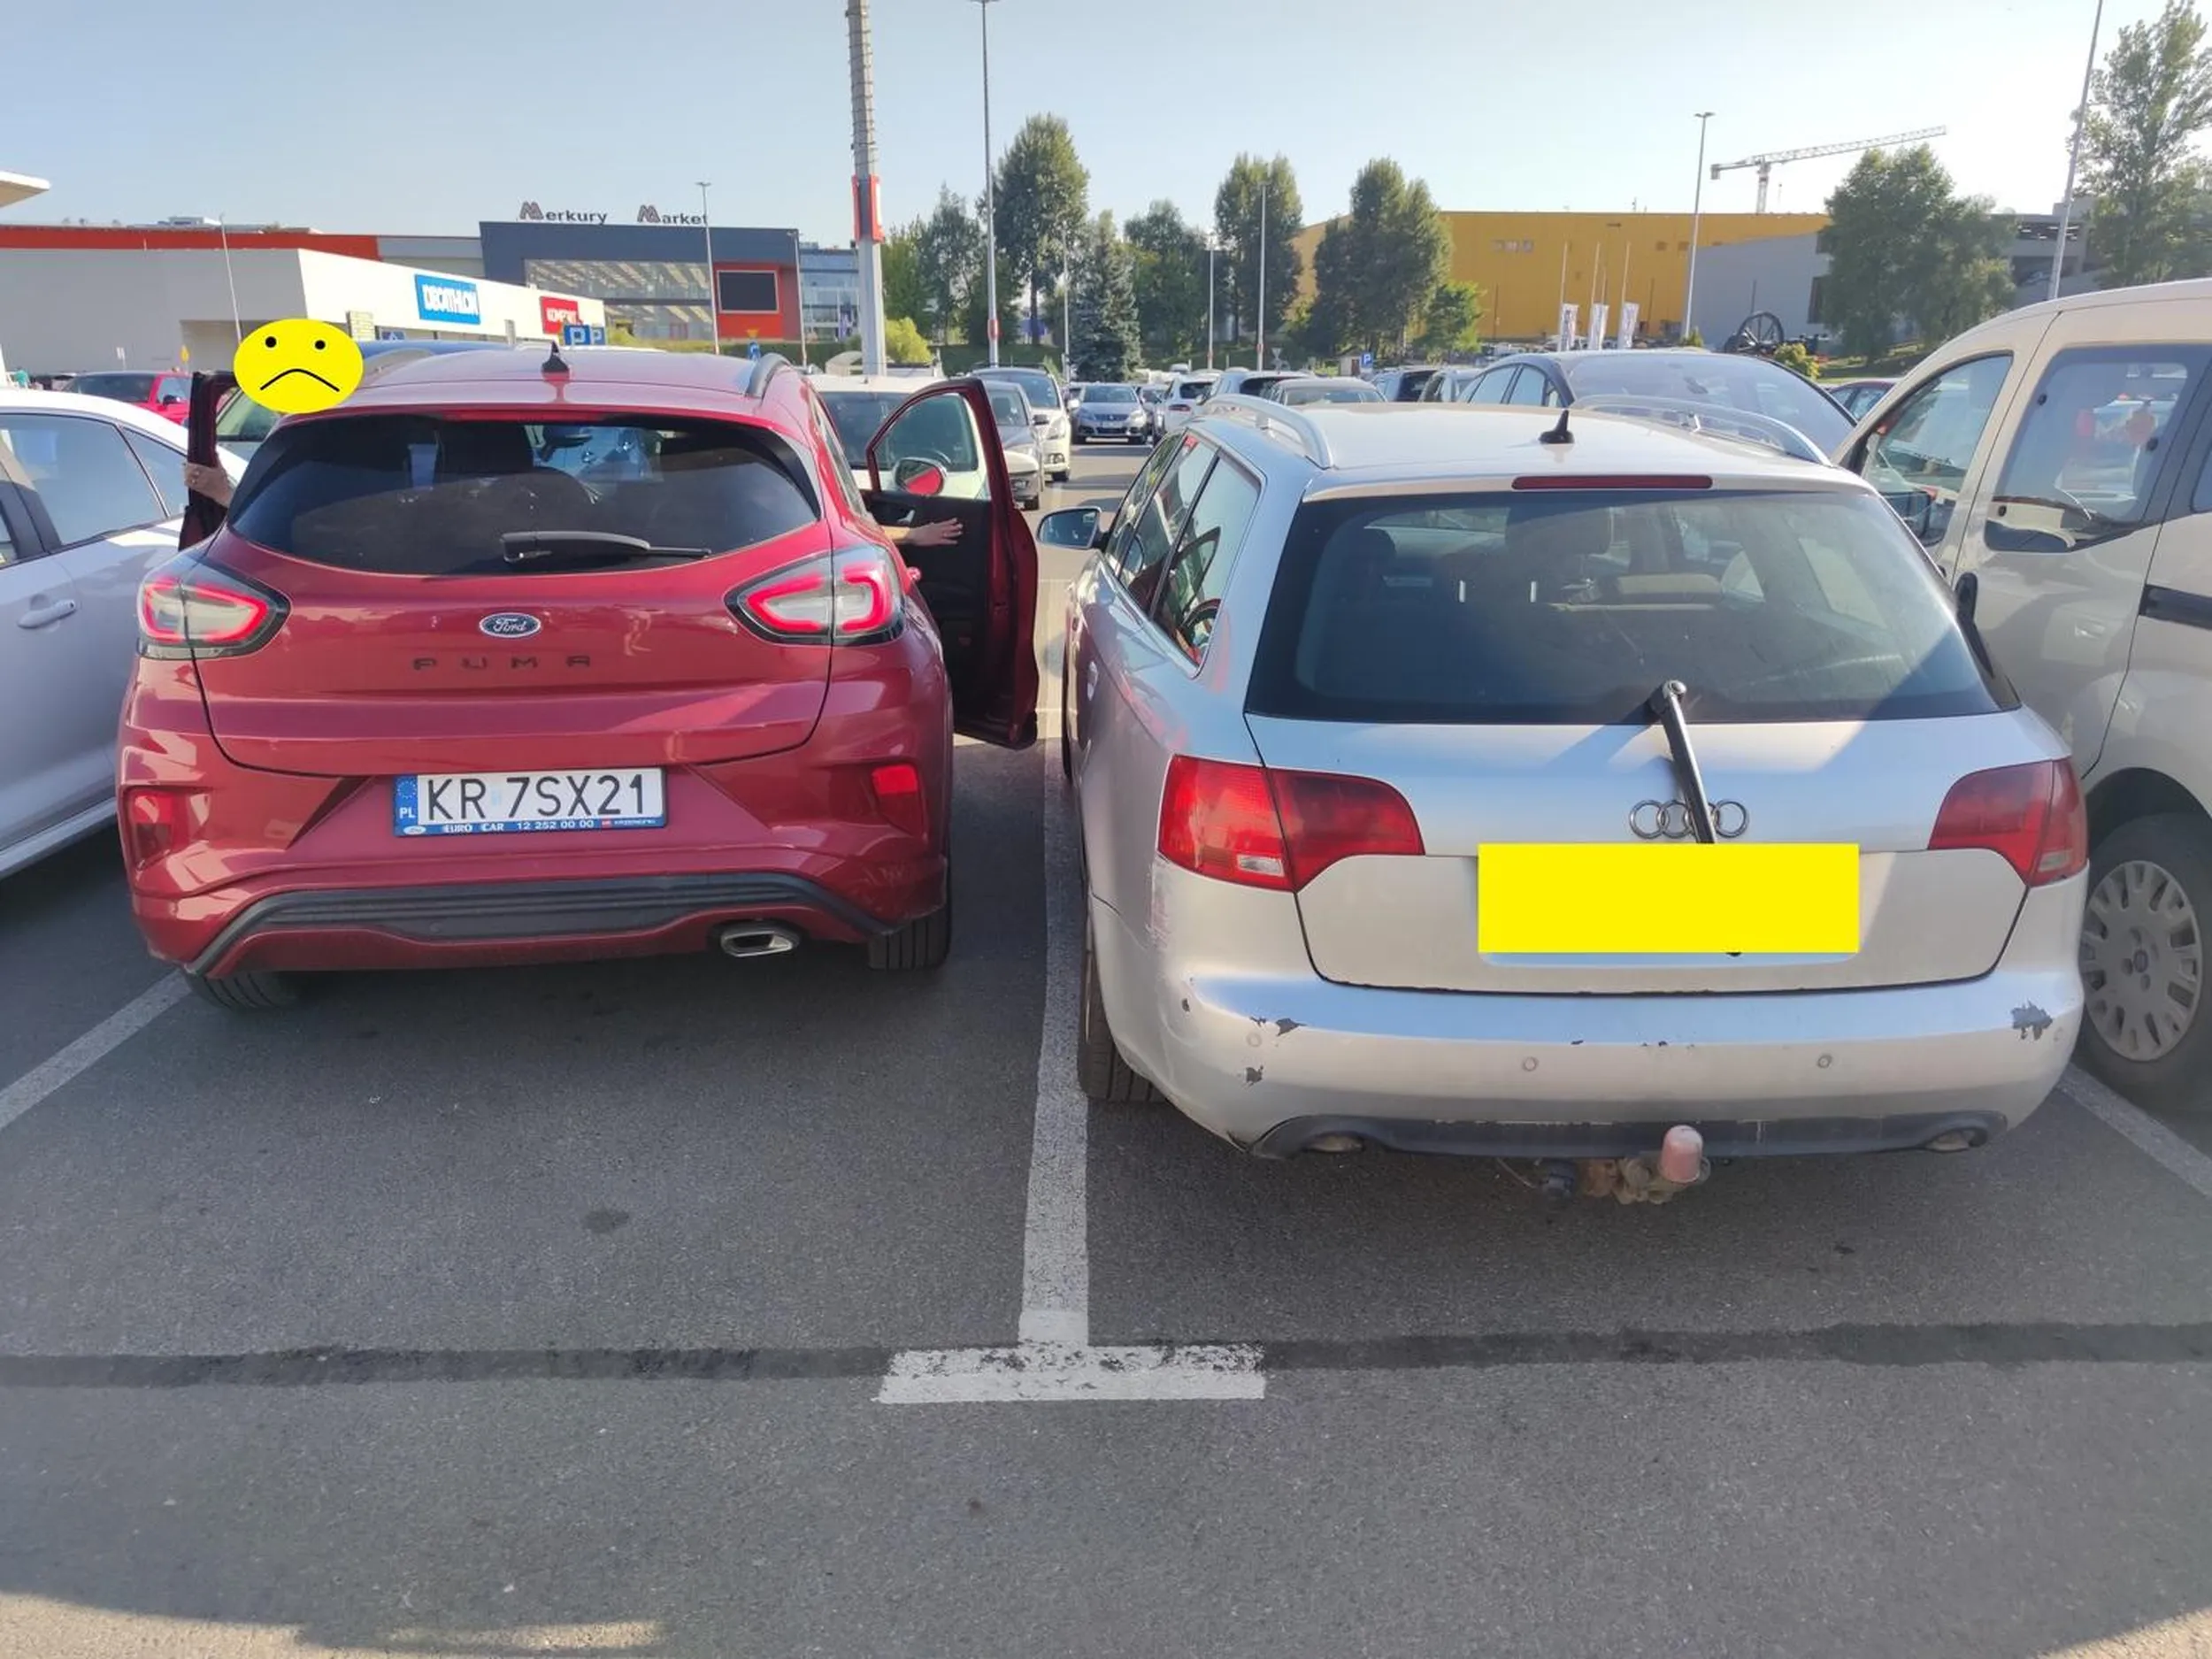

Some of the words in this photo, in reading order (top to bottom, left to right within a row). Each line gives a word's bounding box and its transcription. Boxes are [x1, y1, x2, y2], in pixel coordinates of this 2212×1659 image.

[519, 201, 608, 225] Merkury
[637, 204, 708, 225] Market
[421, 284, 480, 316] DECATHLON
[570, 327, 586, 345] P
[493, 617, 526, 633] Ford
[412, 655, 590, 671] PUMA
[427, 778, 486, 820] KR
[506, 774, 644, 818] 7SX21
[399, 807, 415, 819] PL
[442, 823, 472, 834] EURO
[481, 823, 504, 833] CAR
[516, 822, 532, 831] 12
[534, 821, 557, 831] 252
[560, 821, 576, 830] 00
[580, 819, 595, 829] 00
